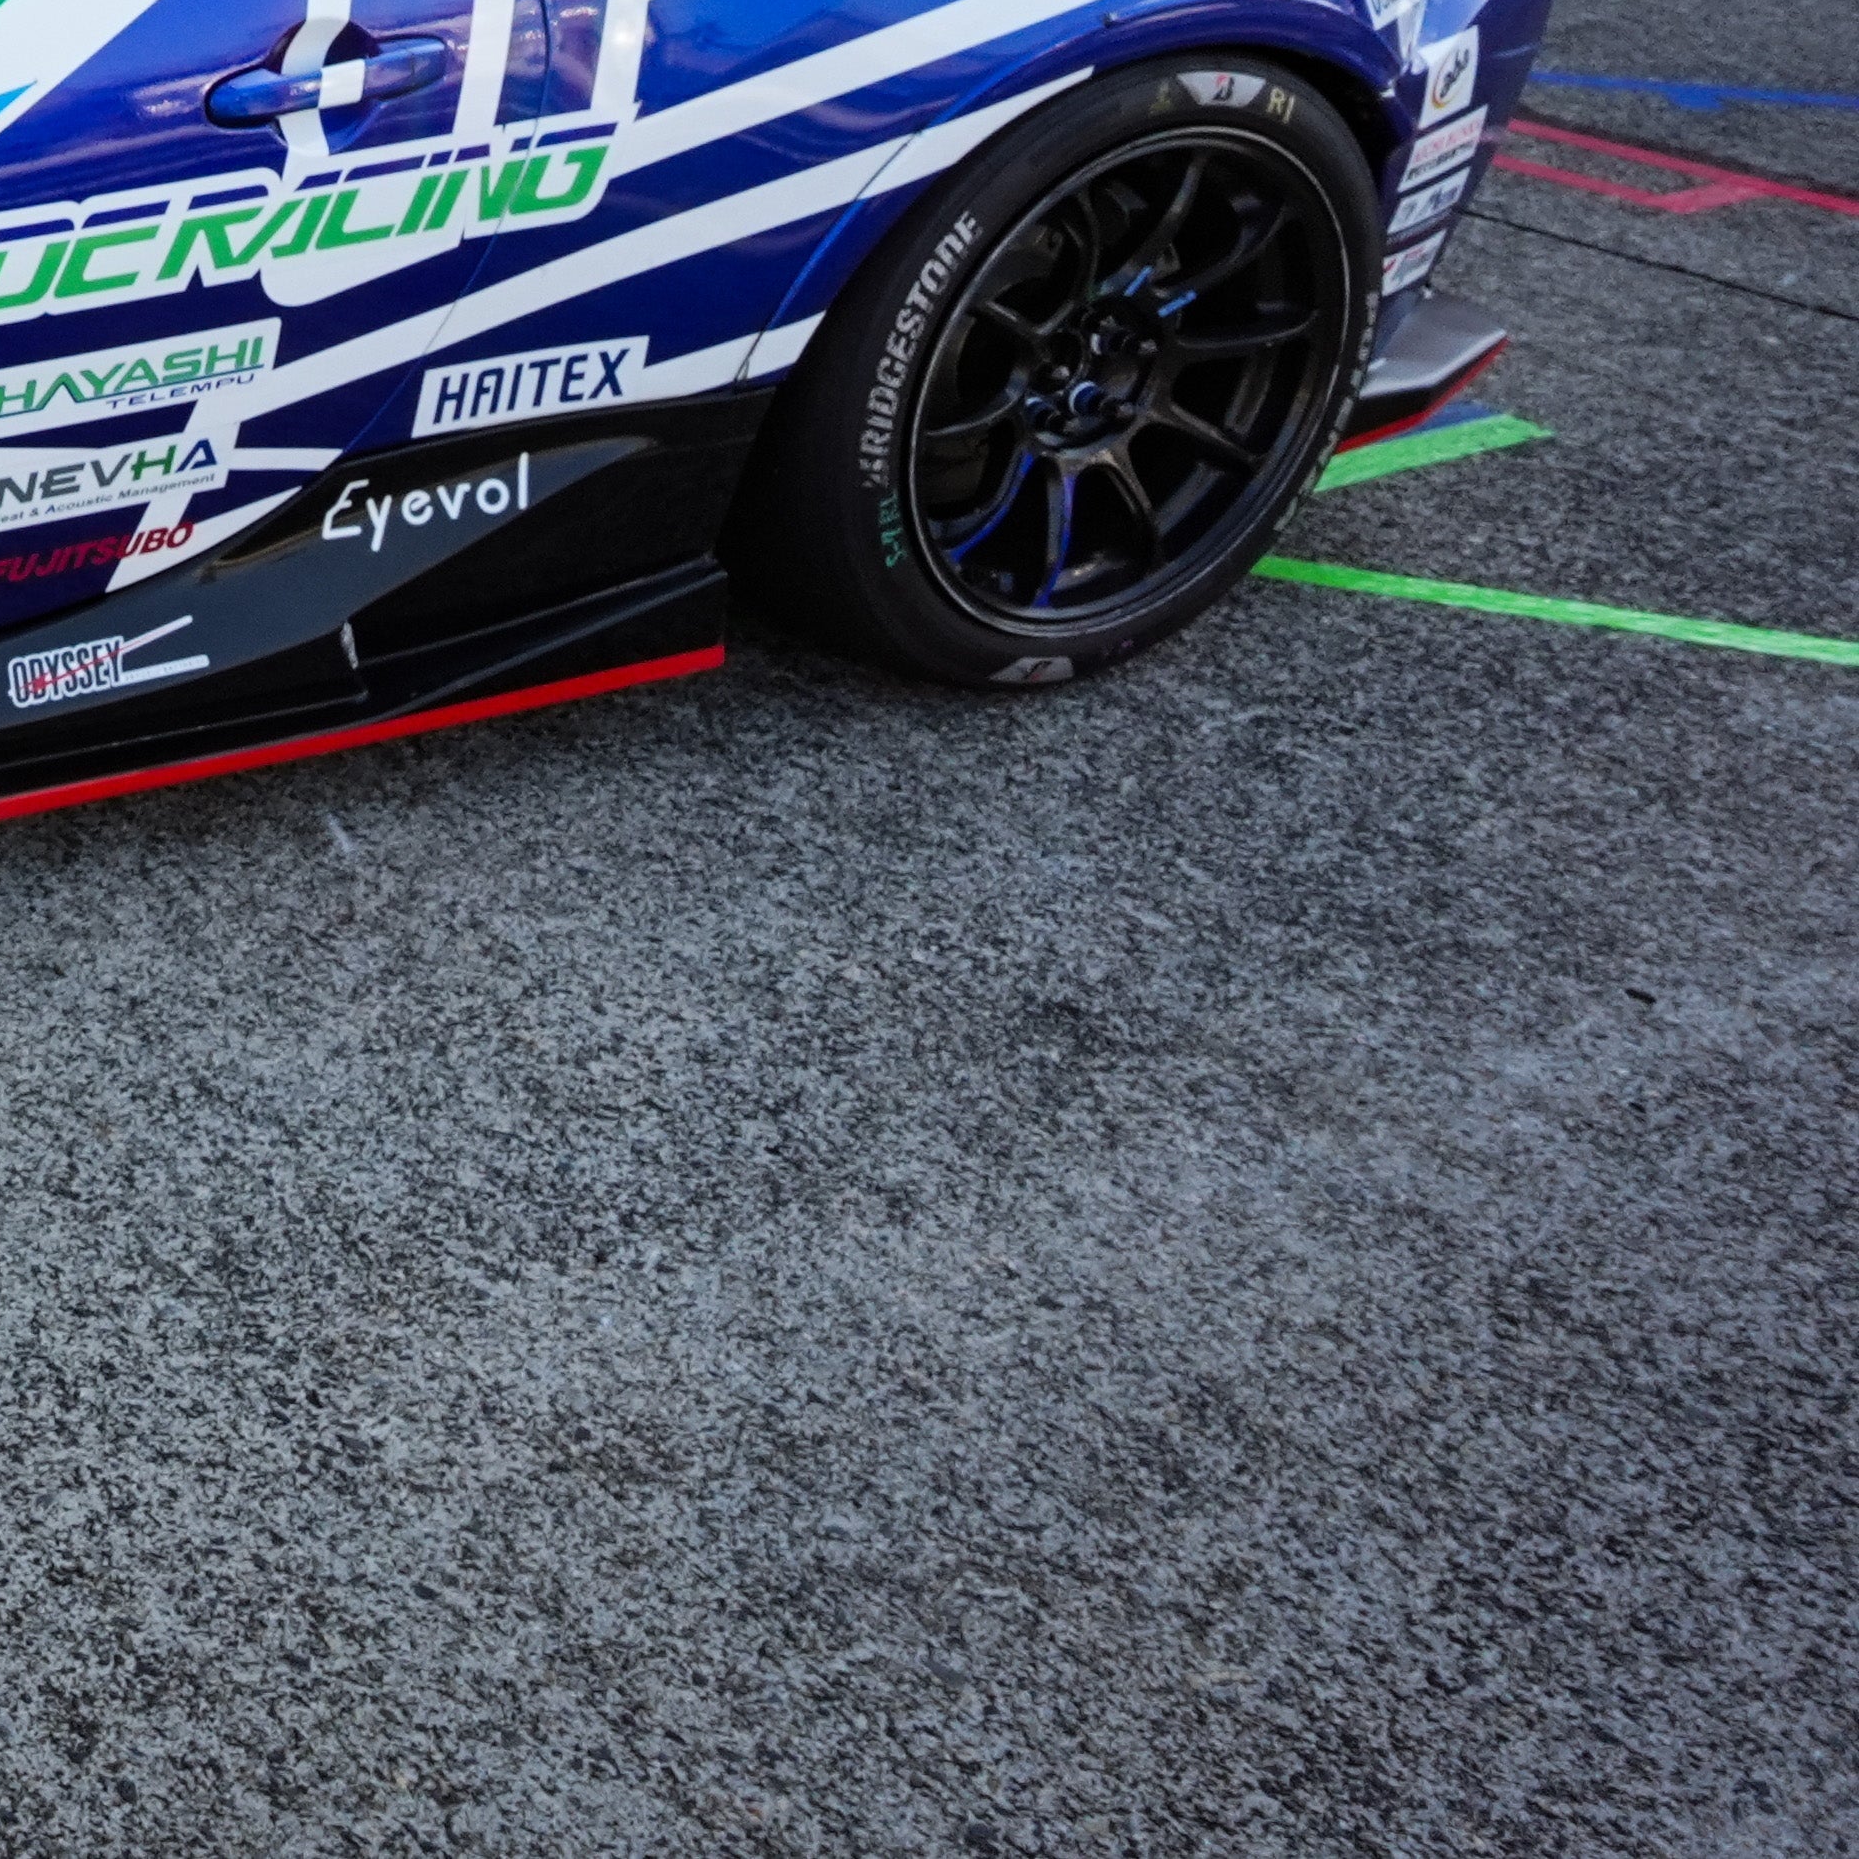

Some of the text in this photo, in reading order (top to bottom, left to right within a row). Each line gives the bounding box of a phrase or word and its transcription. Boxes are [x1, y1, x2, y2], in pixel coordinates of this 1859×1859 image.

[107, 373, 255, 410] TELEMPU
[433, 348, 630, 426] HAITEX
[28, 506, 40, 519] &
[44, 492, 112, 515] Acoustic
[117, 473, 215, 502] Management
[322, 452, 529, 551] Eyevol
[13, 640, 120, 702] ODYSSEY
